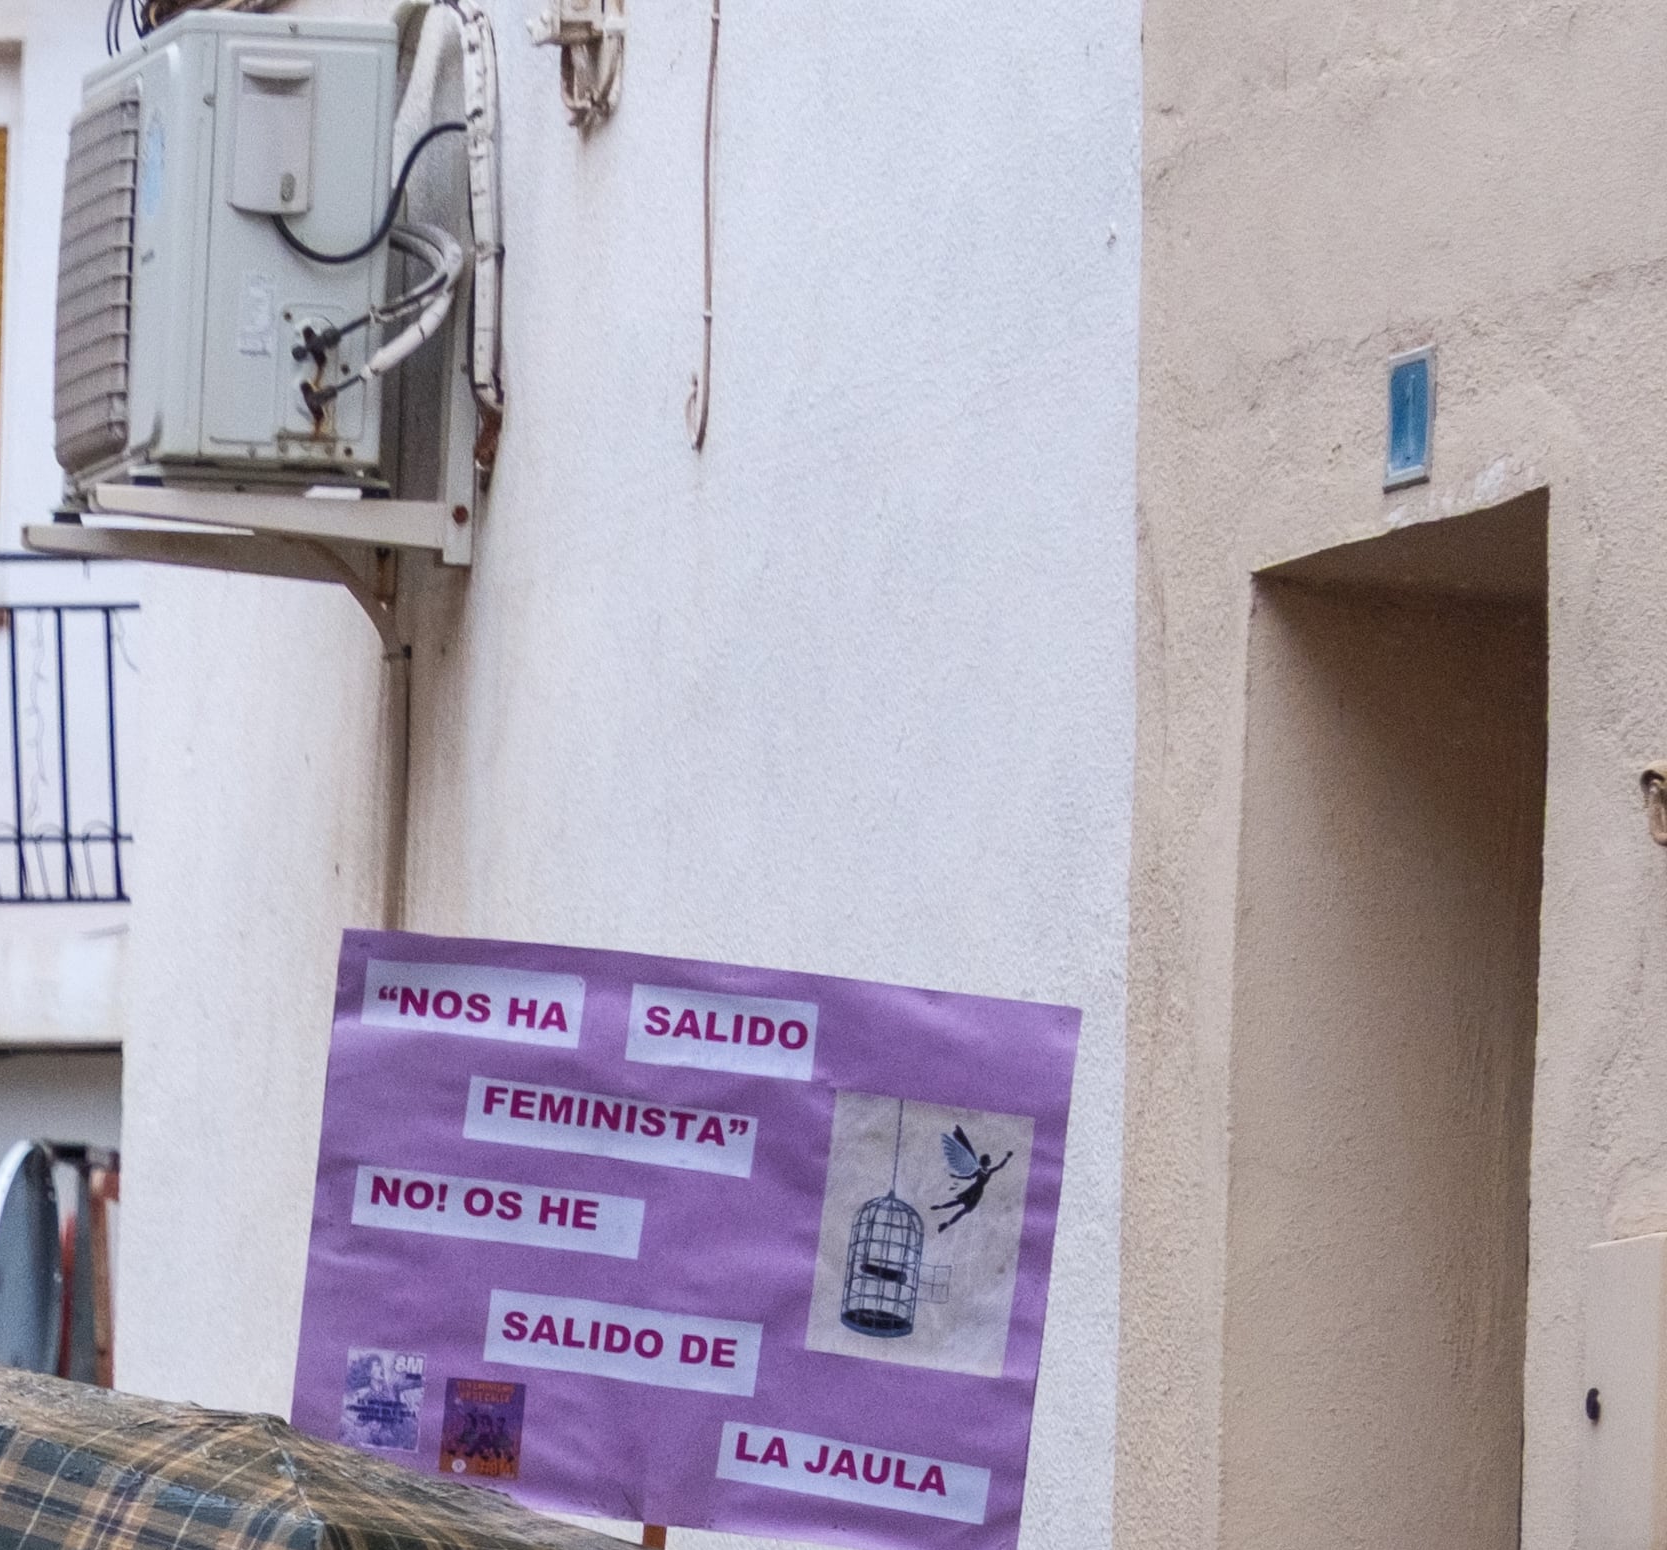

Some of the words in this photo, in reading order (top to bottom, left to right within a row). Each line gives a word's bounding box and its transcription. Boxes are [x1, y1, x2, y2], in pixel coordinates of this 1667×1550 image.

[507, 997, 569, 1033] HA
[643, 1005, 809, 1051] SALIDO
[370, 1175, 450, 1212] NO!
[463, 1186, 524, 1222] OS
[538, 1195, 600, 1231] HE
[501, 1310, 665, 1360] SALIDO
[679, 1334, 739, 1369] DE
[734, 1431, 789, 1469] LA
[804, 1444, 947, 1497] JAULA
